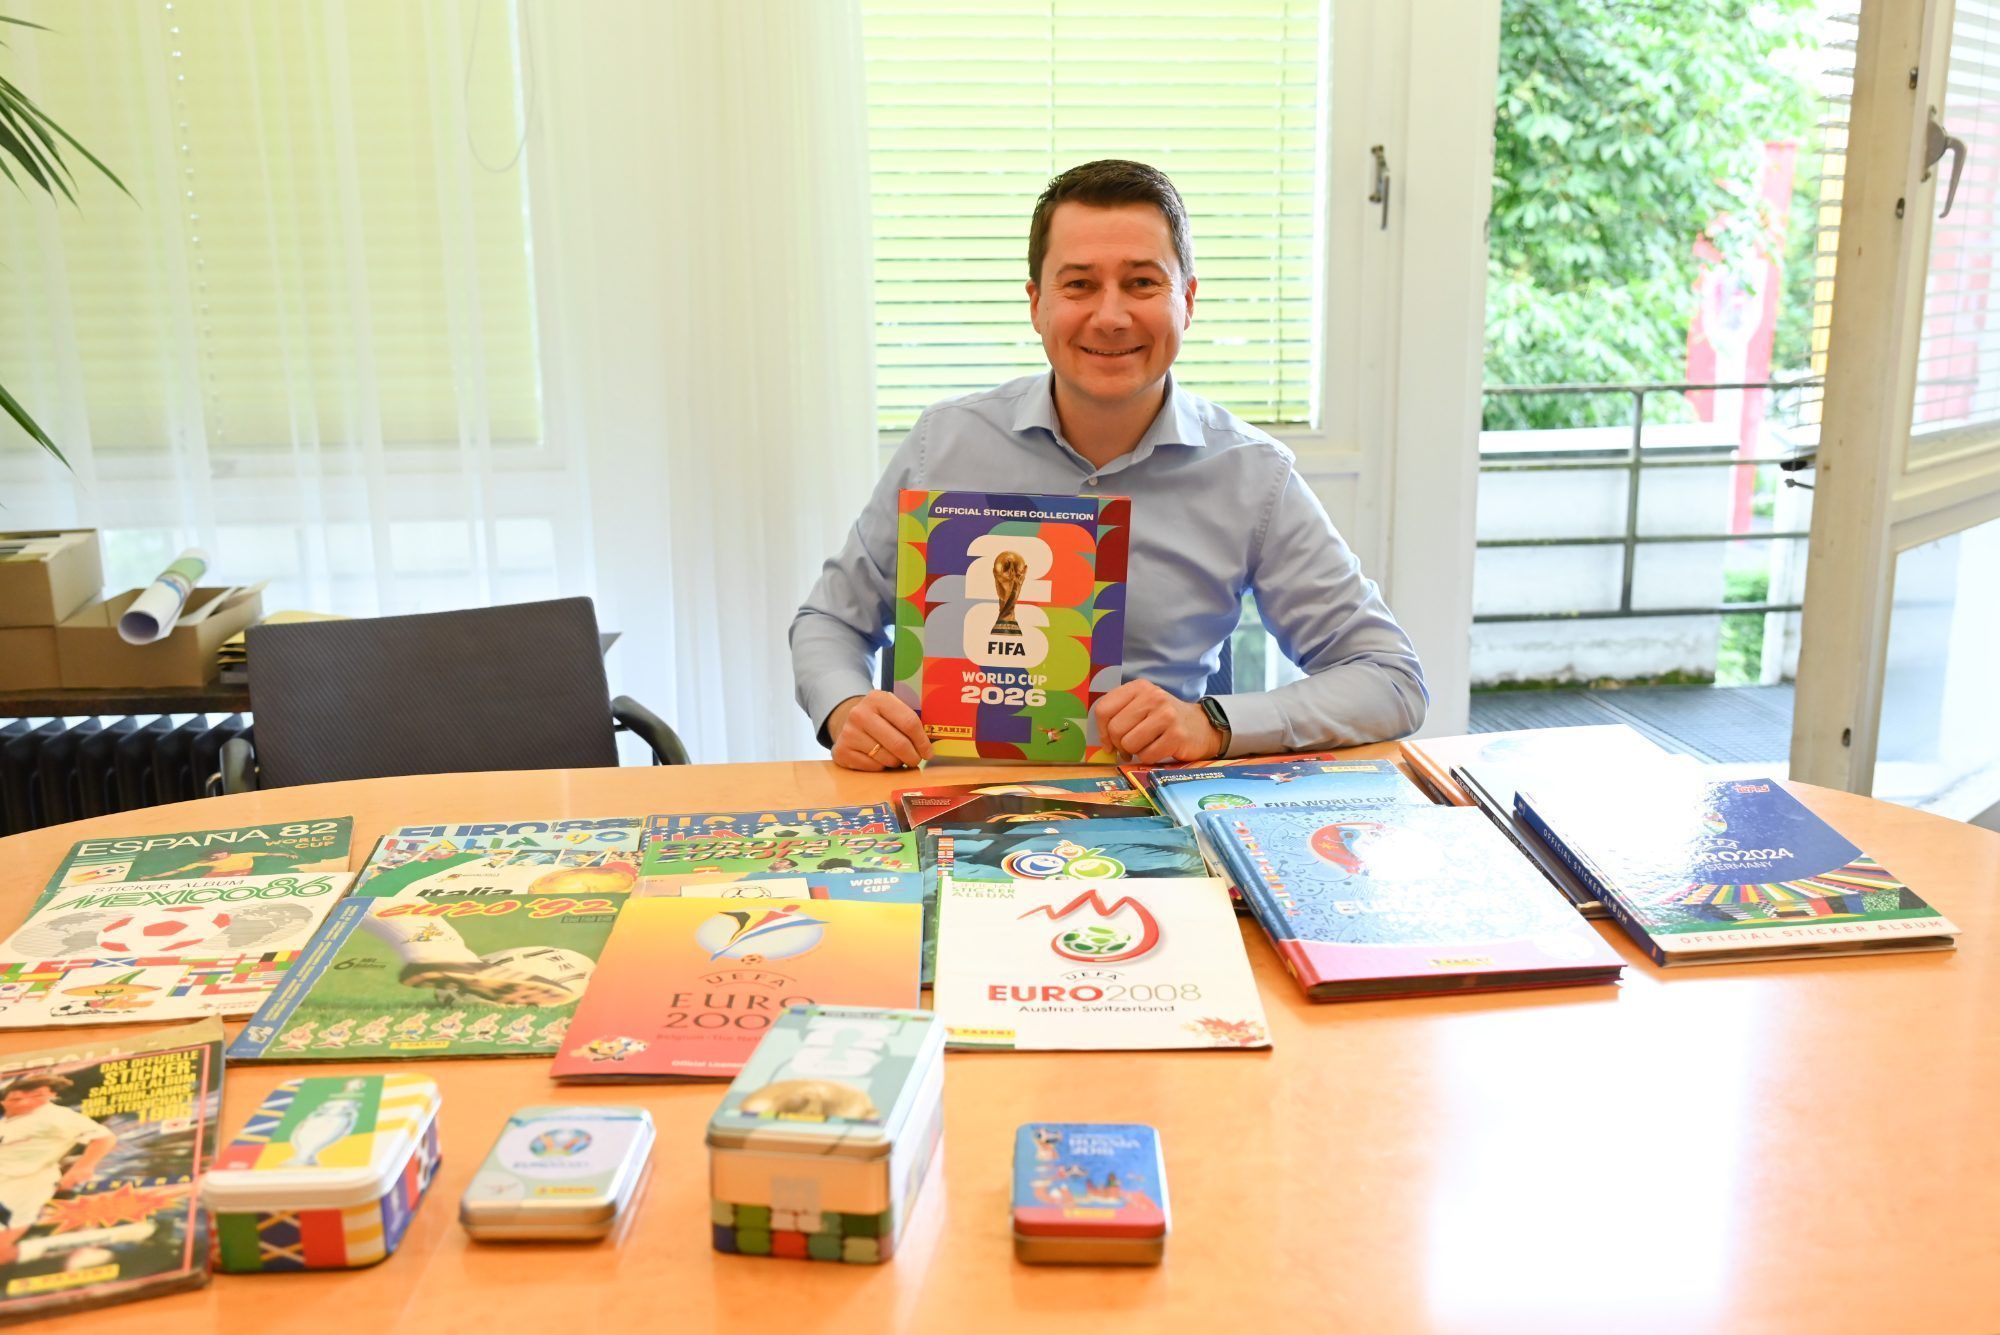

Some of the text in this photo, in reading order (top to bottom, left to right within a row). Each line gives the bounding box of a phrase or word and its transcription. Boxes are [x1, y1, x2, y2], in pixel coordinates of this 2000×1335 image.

[935, 506, 1094, 521] OFFICIAL STICKER COLLECTION
[987, 641, 1026, 656] FIFA
[962, 671, 1048, 686] WORLD CUP
[960, 685, 1047, 707] 2026
[937, 726, 971, 734] PANINI
[1301, 797, 1363, 806] WORLD
[399, 821, 549, 837] EURO
[76, 821, 339, 857] ESPAÑA 82
[265, 835, 337, 847] WORLD
[294, 841, 335, 850] CUP
[384, 836, 541, 850] ITALIA
[656, 835, 905, 856] EUROPA '96
[653, 848, 829, 864] EUROPE
[1704, 861, 1773, 871] GERMANY
[850, 875, 900, 887] WORLD
[1543, 828, 1628, 925] OFFICIAL STICKER ALBUM
[95, 879, 245, 893] STICKER ALBUM
[863, 885, 891, 894] CUP
[376, 898, 618, 918] euro '92
[1680, 920, 1943, 945] OFFICIAL STICKER ALBUM
[706, 973, 785, 987] UEFA
[1065, 971, 1118, 981] UEFA
[988, 984, 1202, 1002] EURO2008
[670, 992, 816, 1010] EURO
[663, 1012, 771, 1030] 200
[100, 1059, 129, 1074] DAS
[130, 1050, 199, 1069] OFFIZIELLE
[103, 1060, 198, 1087] STICKER-
[88, 1073, 197, 1099] SAMMELALBUM
